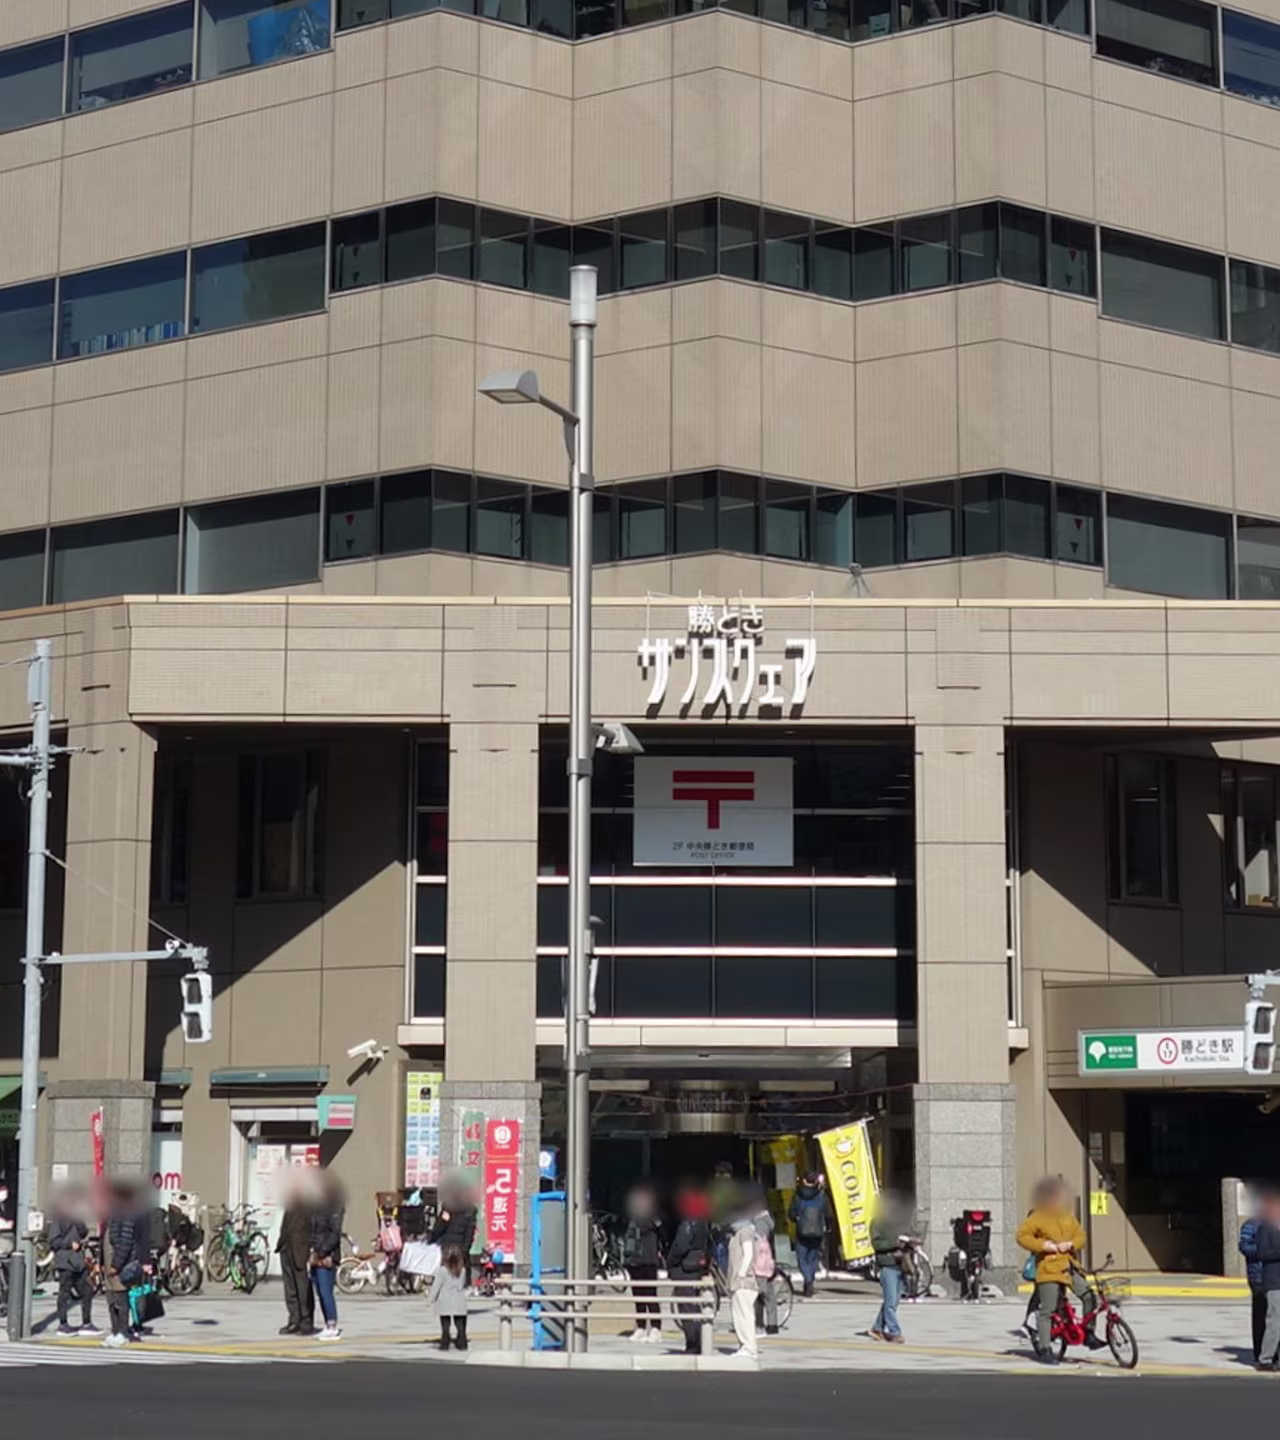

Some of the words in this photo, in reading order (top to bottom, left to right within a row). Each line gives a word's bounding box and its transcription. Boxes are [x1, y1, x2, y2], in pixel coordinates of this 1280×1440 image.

[688, 604, 765, 633] 勝どき
[638, 638, 816, 704] サンスクェア
[1181, 1039, 1235, 1055] 勝どき駅
[840, 1160, 870, 1250] COFFEE
